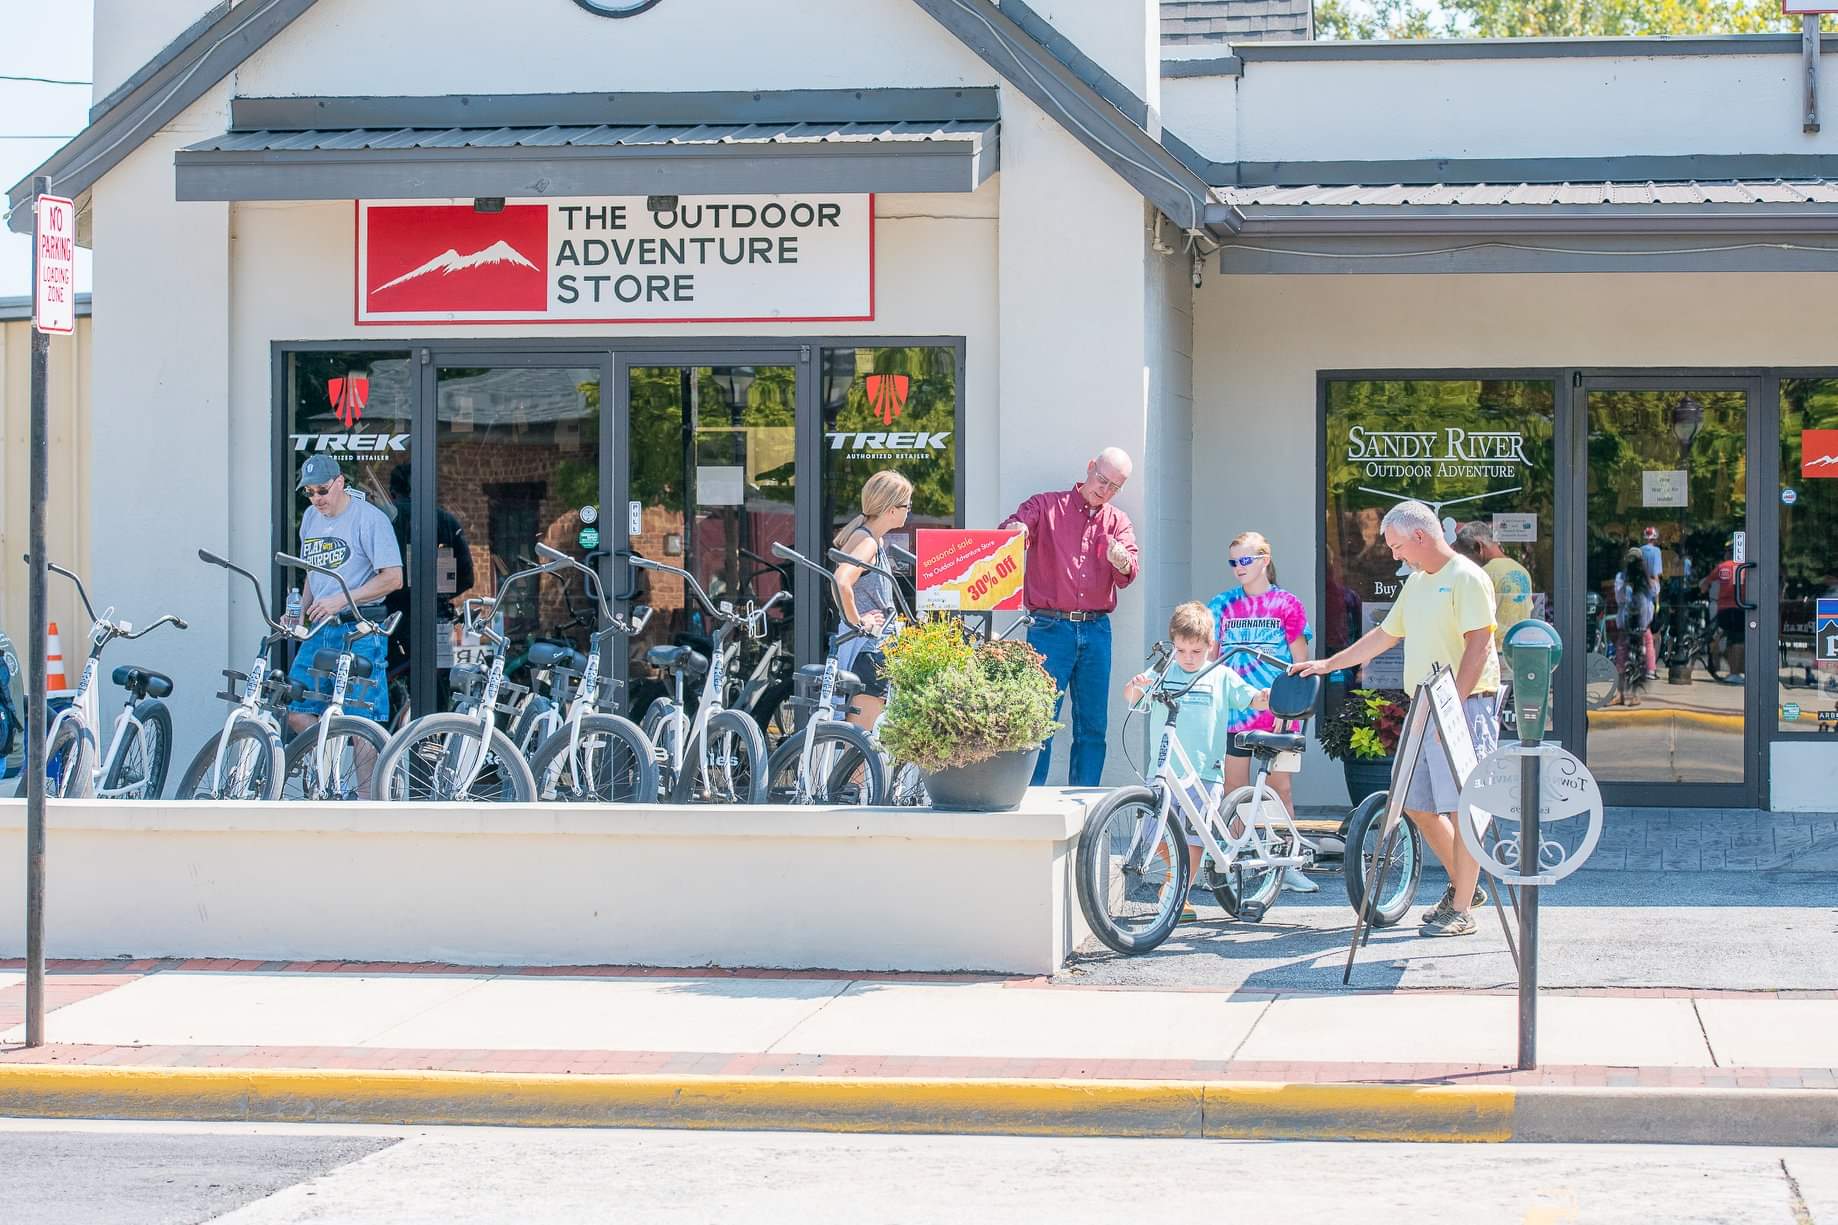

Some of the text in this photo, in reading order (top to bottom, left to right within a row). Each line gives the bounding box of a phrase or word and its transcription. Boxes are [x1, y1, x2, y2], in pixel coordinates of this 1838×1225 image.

[49, 206, 63, 232] NO
[558, 203, 841, 230] THE OUTDOOR
[42, 234, 71, 261] PARKING
[555, 236, 798, 266] ADVENTURE
[43, 263, 69, 284] LOADING
[47, 285, 64, 302] ZONE
[557, 274, 694, 304] STORE
[289, 433, 411, 451] TREK
[825, 432, 952, 449] TREK
[1348, 425, 1533, 466] SANDY RIVER
[1366, 462, 1515, 478] OUTDOOR ADVENTURE
[304, 541, 324, 556] PLAY
[923, 537, 973, 568] seasonal sale
[933, 561, 955, 574] Outdoor
[956, 547, 981, 562] Adventure
[981, 540, 995, 550] Store
[967, 571, 999, 601] 30%
[995, 554, 1017, 578] Off
[1374, 581, 1397, 598] Buy
[1227, 619, 1281, 629] TOURNAMENT
